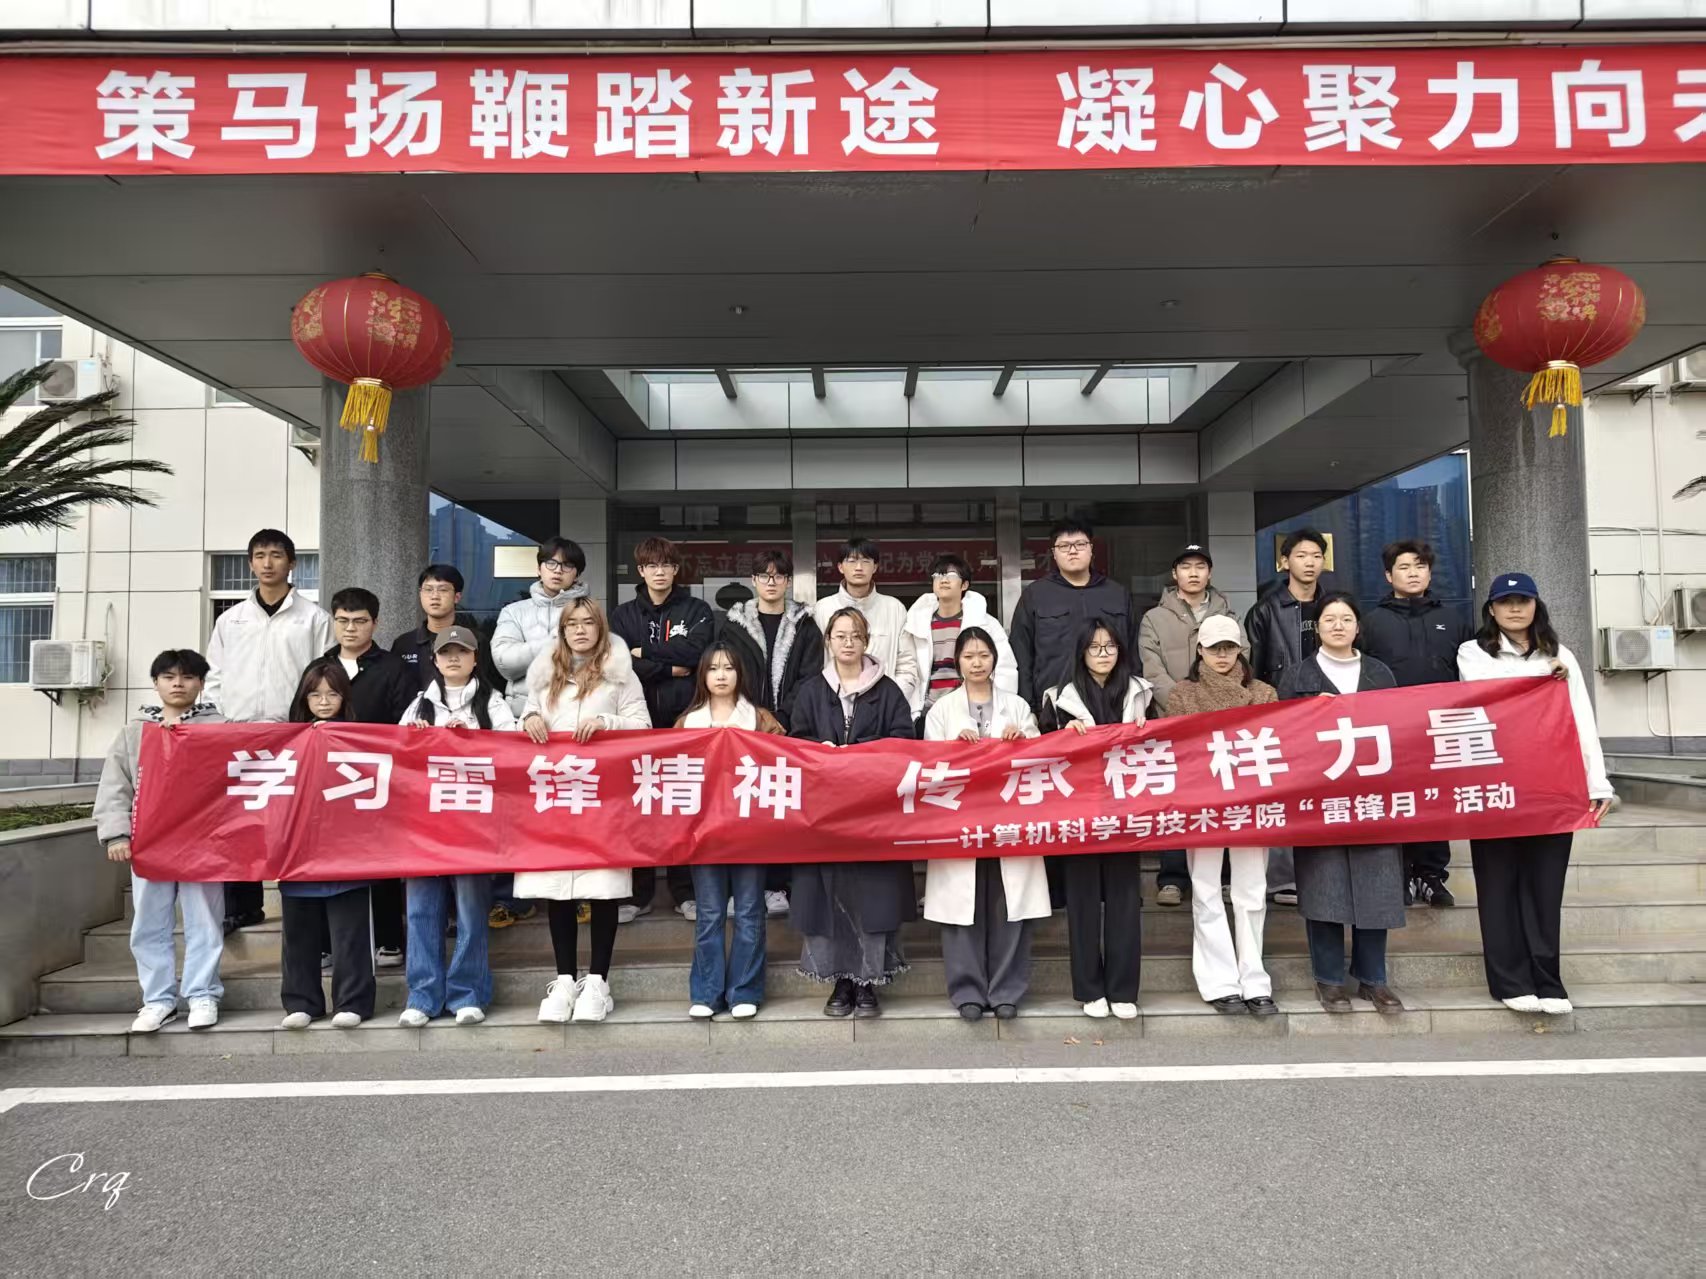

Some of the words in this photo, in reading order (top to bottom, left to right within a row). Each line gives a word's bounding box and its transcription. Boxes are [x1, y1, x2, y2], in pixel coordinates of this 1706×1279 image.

[96, 67, 940, 161] 策马扬鞭踏新途
[227, 748, 804, 820] 学习雷锋精神
[897, 706, 1504, 814] 传承榜样力量
